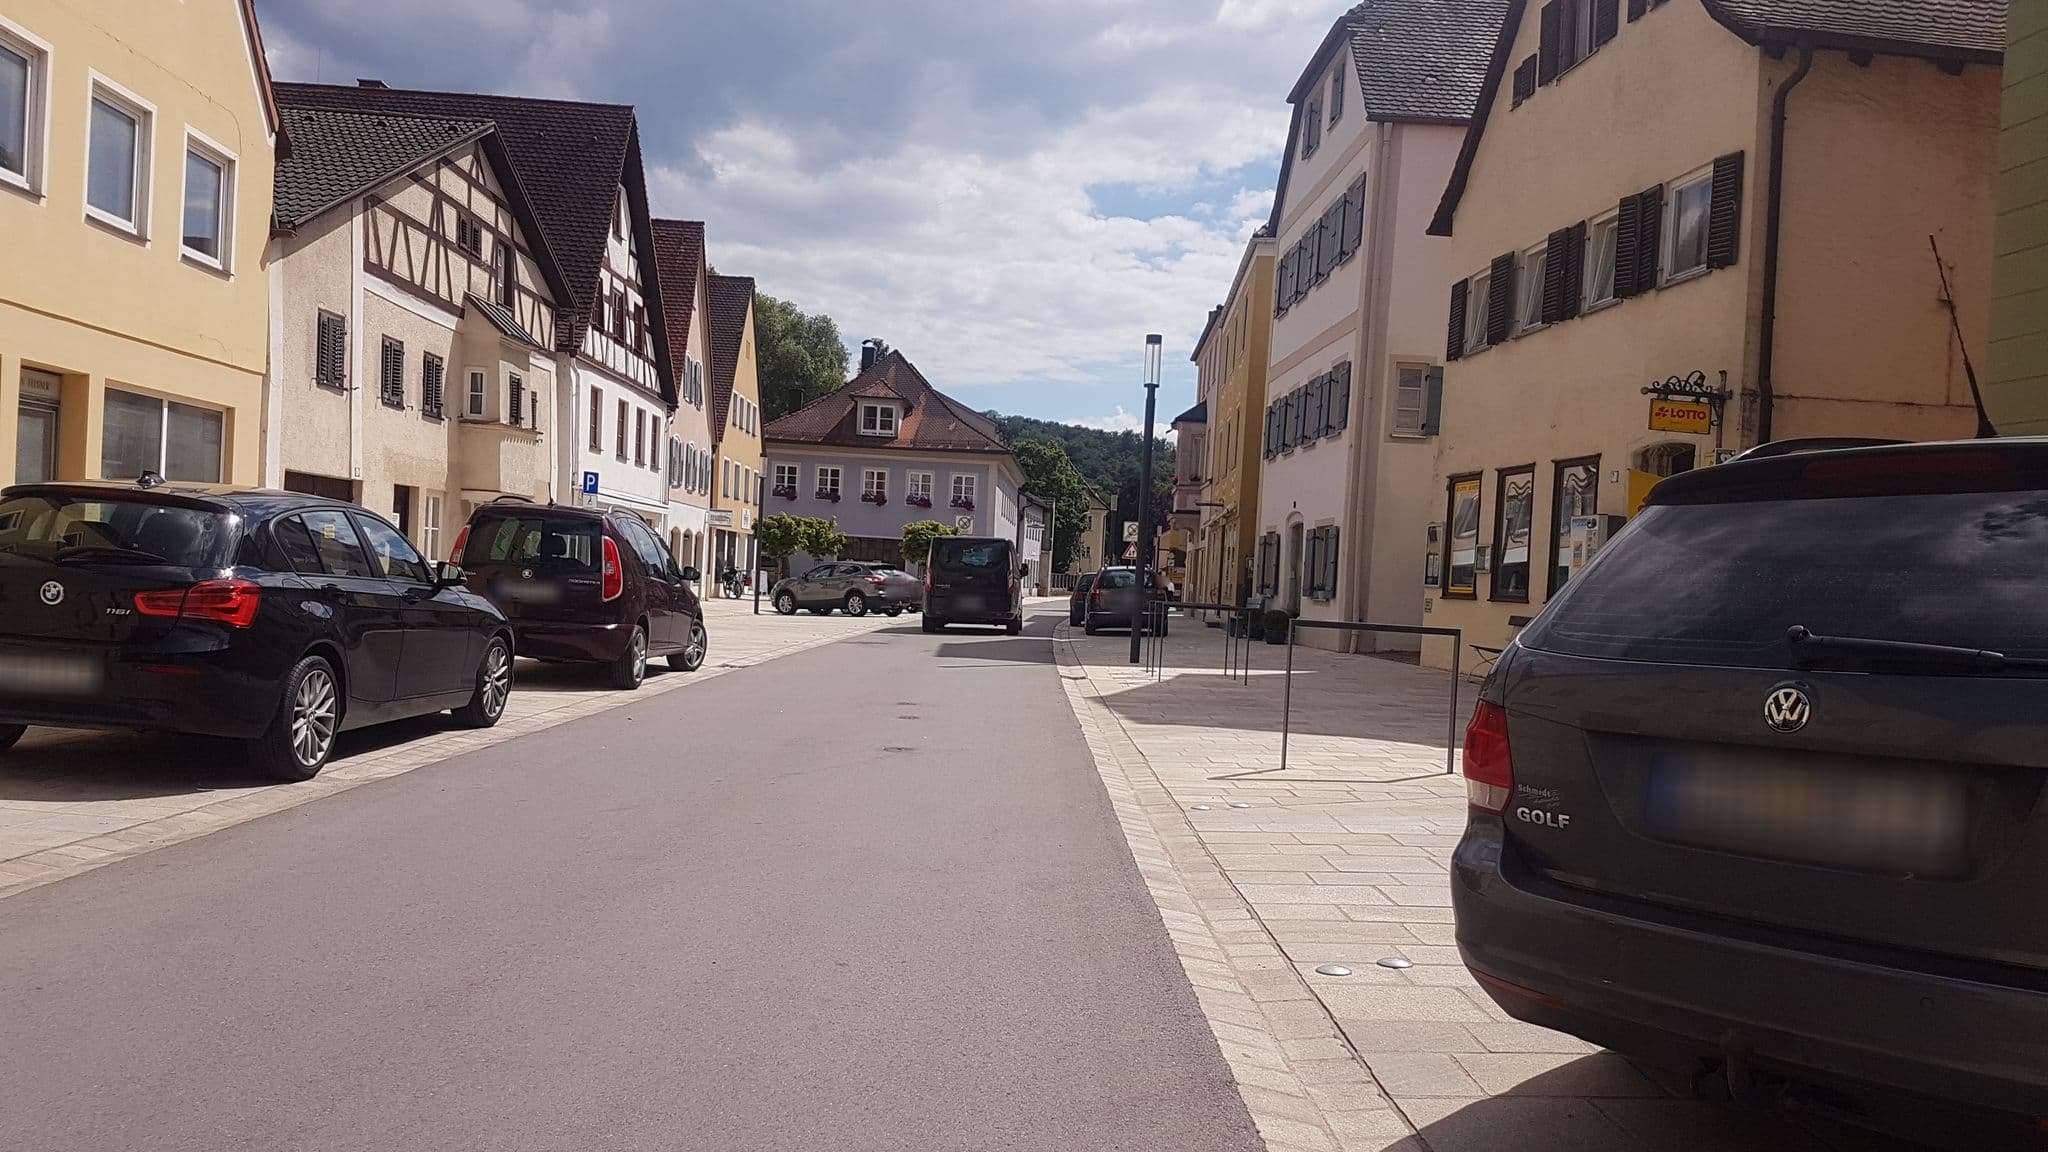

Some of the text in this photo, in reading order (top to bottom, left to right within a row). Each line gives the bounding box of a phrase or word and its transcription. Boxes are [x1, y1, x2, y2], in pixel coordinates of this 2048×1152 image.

[1670, 408, 1707, 420] LOTTO
[586, 474, 596, 491] P
[1517, 783, 1551, 798] Schmidt
[1516, 806, 1570, 829] GOLF
